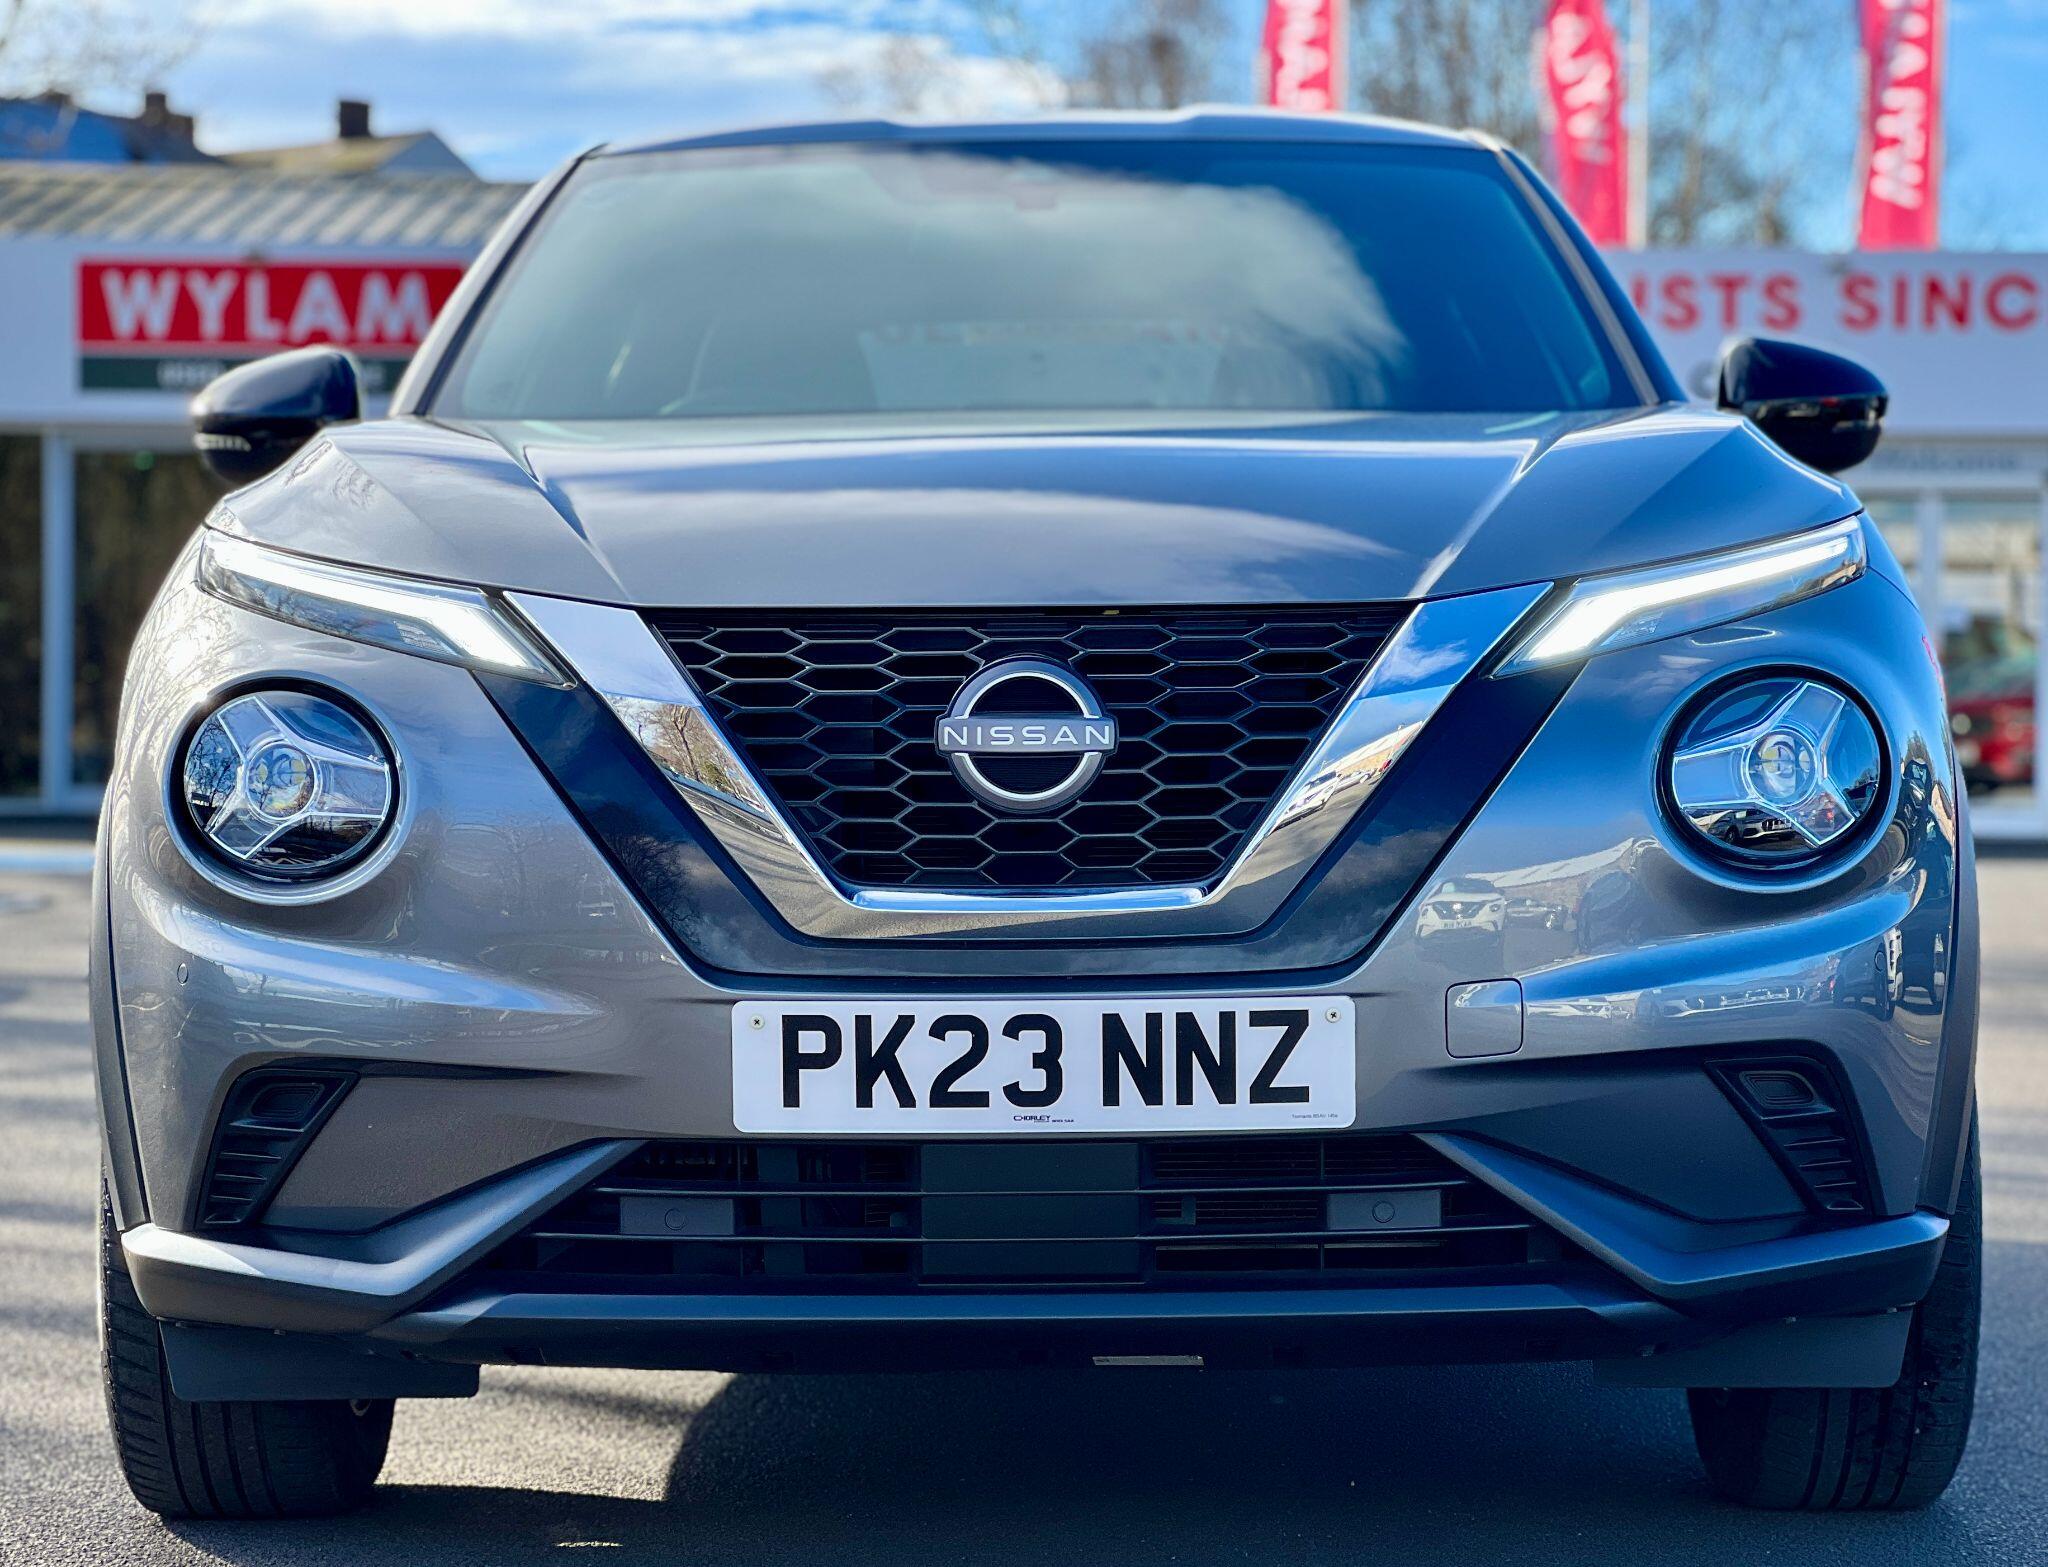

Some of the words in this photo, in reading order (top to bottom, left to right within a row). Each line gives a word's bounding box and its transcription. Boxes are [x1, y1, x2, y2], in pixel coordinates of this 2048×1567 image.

[101, 268, 432, 342] WYLAM
[944, 725, 1110, 746] NISSAN
[781, 1013, 1064, 1108] PK23
[1101, 1009, 1310, 1107] NNZ
